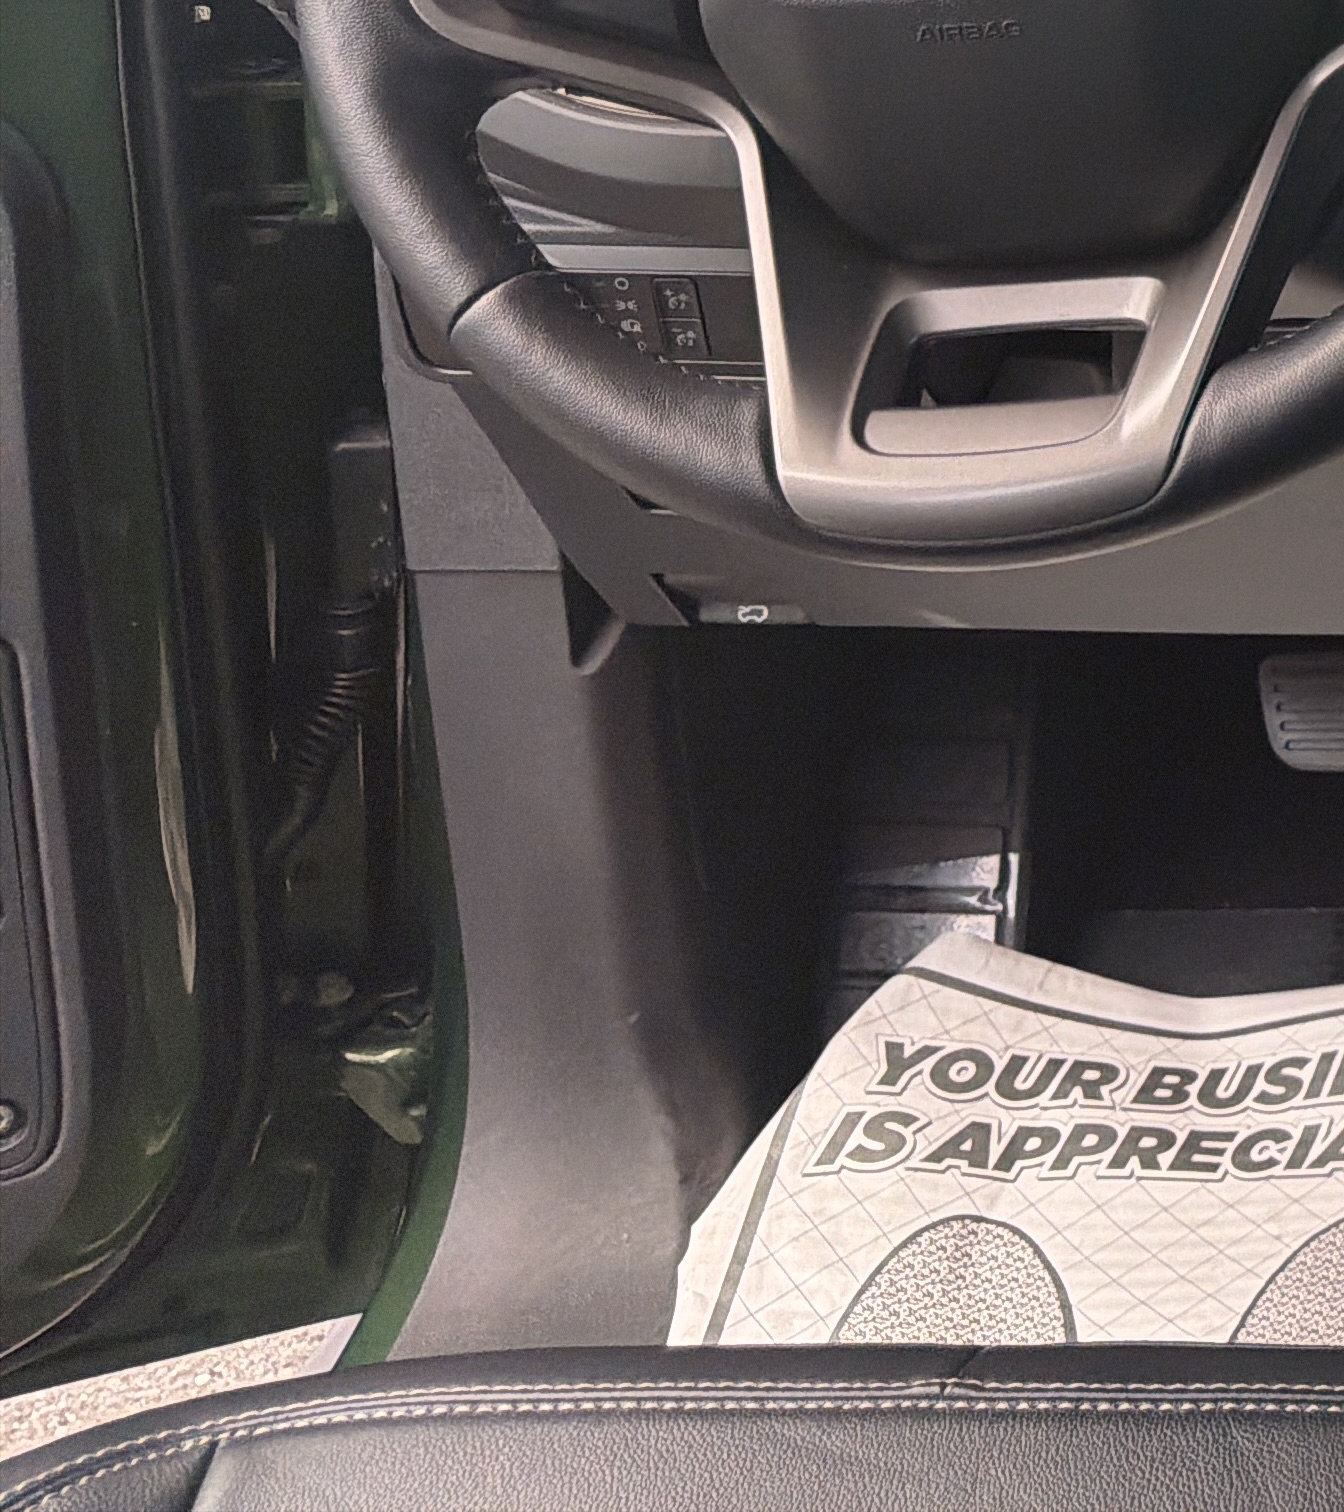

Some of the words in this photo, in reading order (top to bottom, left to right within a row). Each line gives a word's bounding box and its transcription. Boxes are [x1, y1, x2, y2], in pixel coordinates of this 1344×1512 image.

[917, 19, 1022, 42] AIRBAG
[868, 1038, 1124, 1108] YOUR
[806, 1108, 924, 1178] IS
